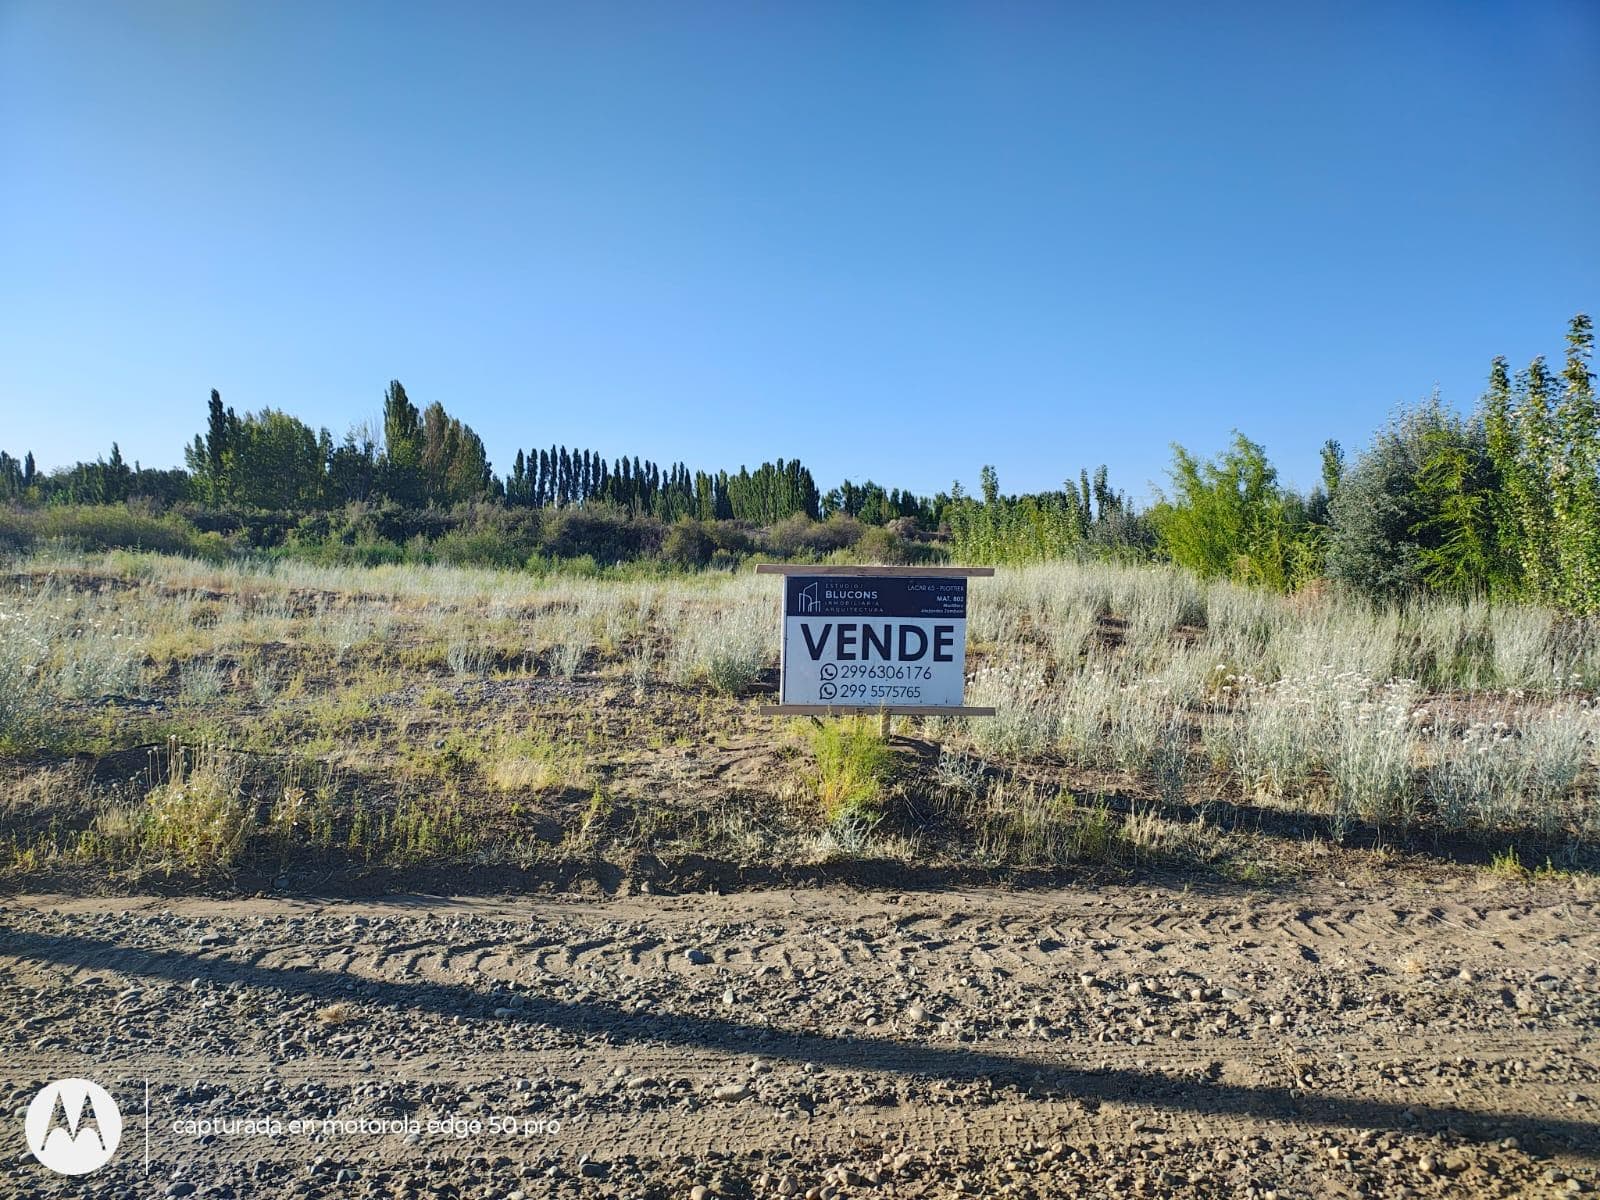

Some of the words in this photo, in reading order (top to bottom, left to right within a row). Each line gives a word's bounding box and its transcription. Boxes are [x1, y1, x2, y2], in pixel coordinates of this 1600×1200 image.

[825, 590, 878, 599] BLUCONS
[800, 623, 954, 662] VENDE
[841, 664, 932, 680] 2996306176
[840, 684, 867, 698] 299
[871, 685, 921, 698] 5575765
